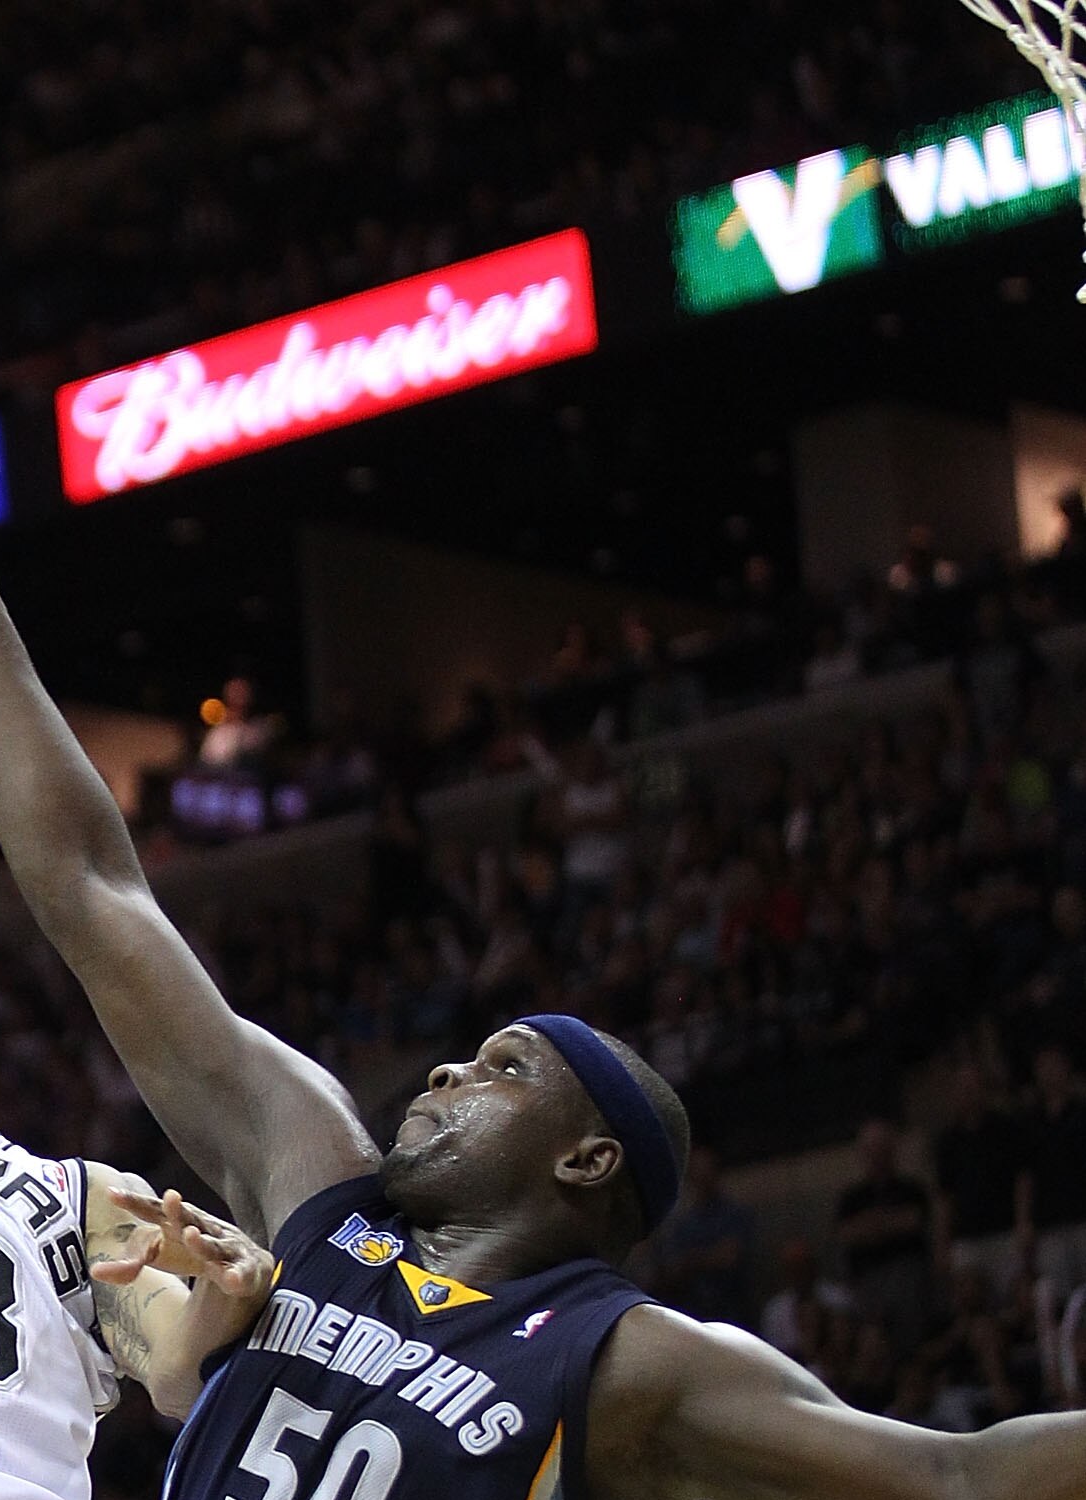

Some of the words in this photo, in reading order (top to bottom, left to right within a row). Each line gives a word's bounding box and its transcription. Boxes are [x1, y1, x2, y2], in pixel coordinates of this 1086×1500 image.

[885, 104, 1086, 228] VALE
[72, 276, 572, 493] Budweiser
[247, 1288, 524, 1456] MEMPHIS
